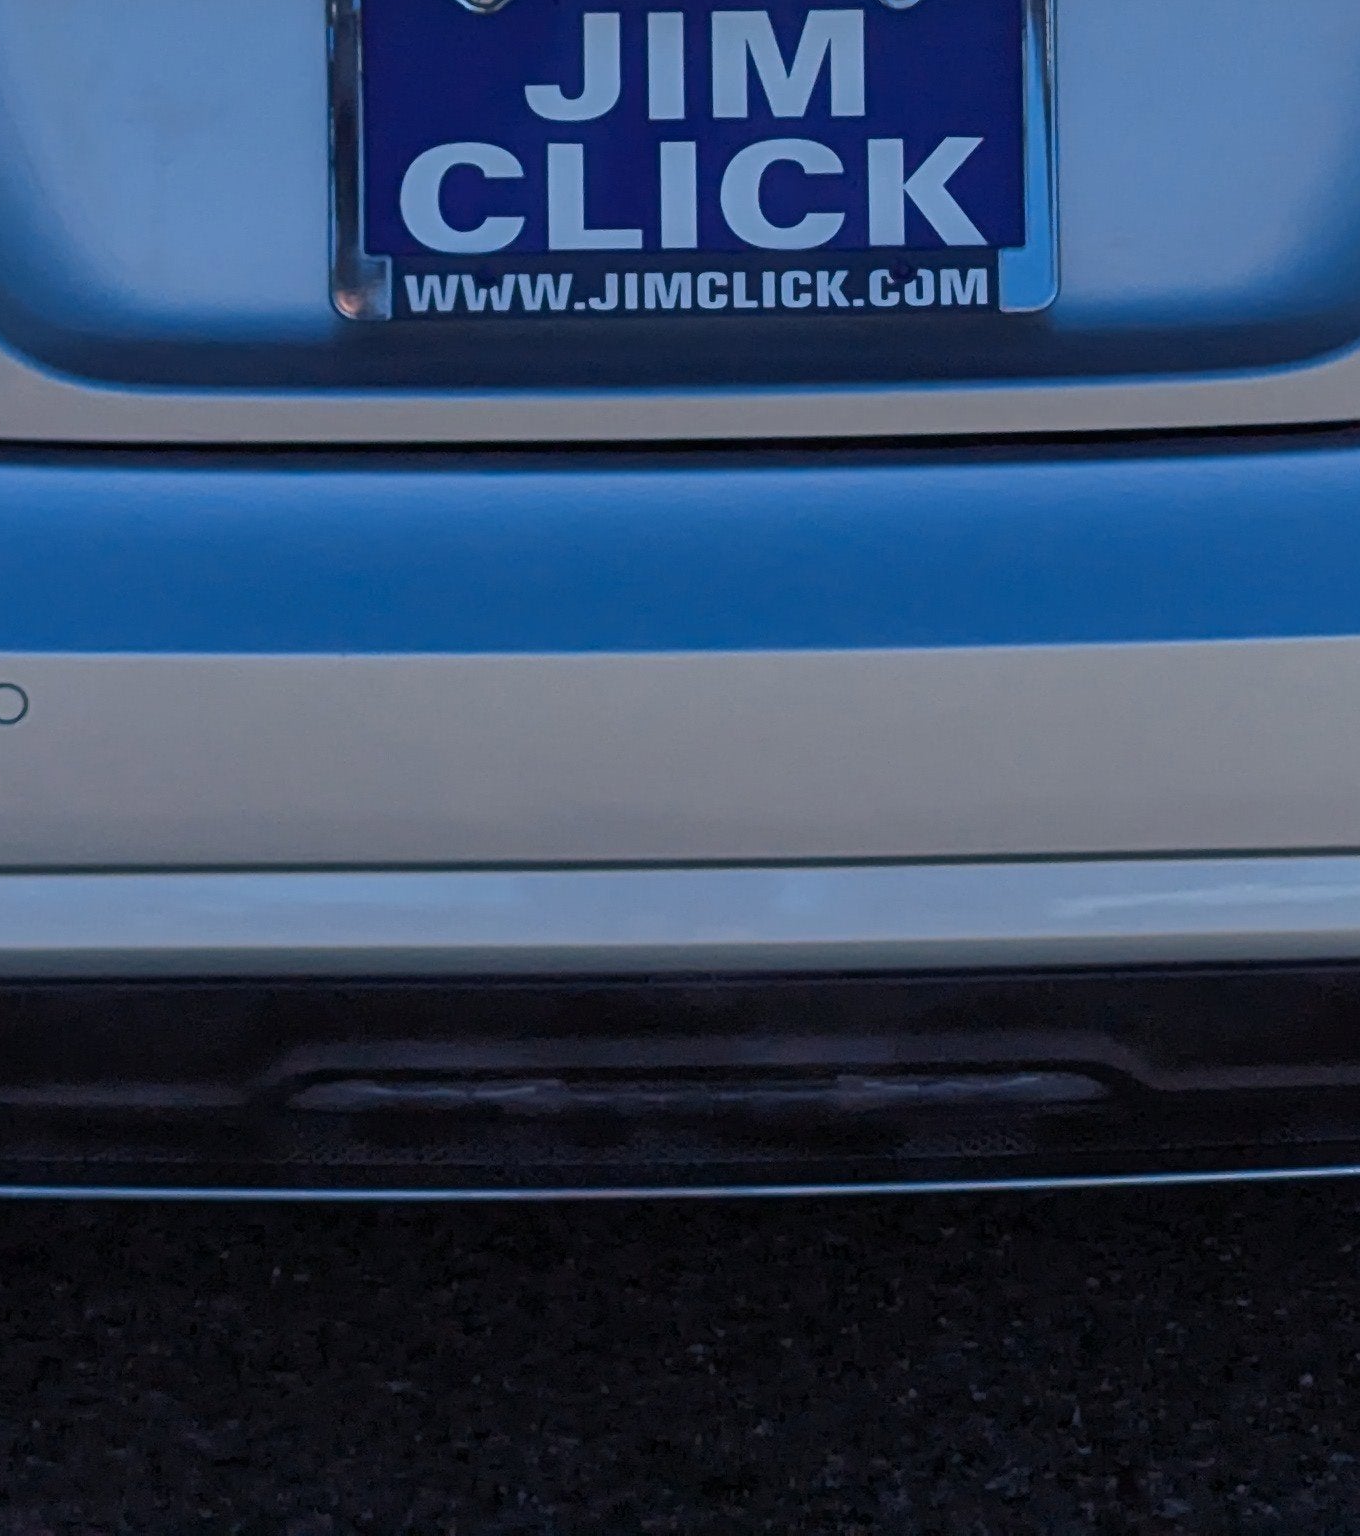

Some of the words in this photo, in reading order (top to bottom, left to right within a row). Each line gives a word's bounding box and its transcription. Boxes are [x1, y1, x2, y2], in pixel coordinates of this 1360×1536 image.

[524, 9, 865, 121] JIM
[399, 136, 988, 252] CLICK
[403, 267, 988, 312] WWW.JIMCLICK.COM
